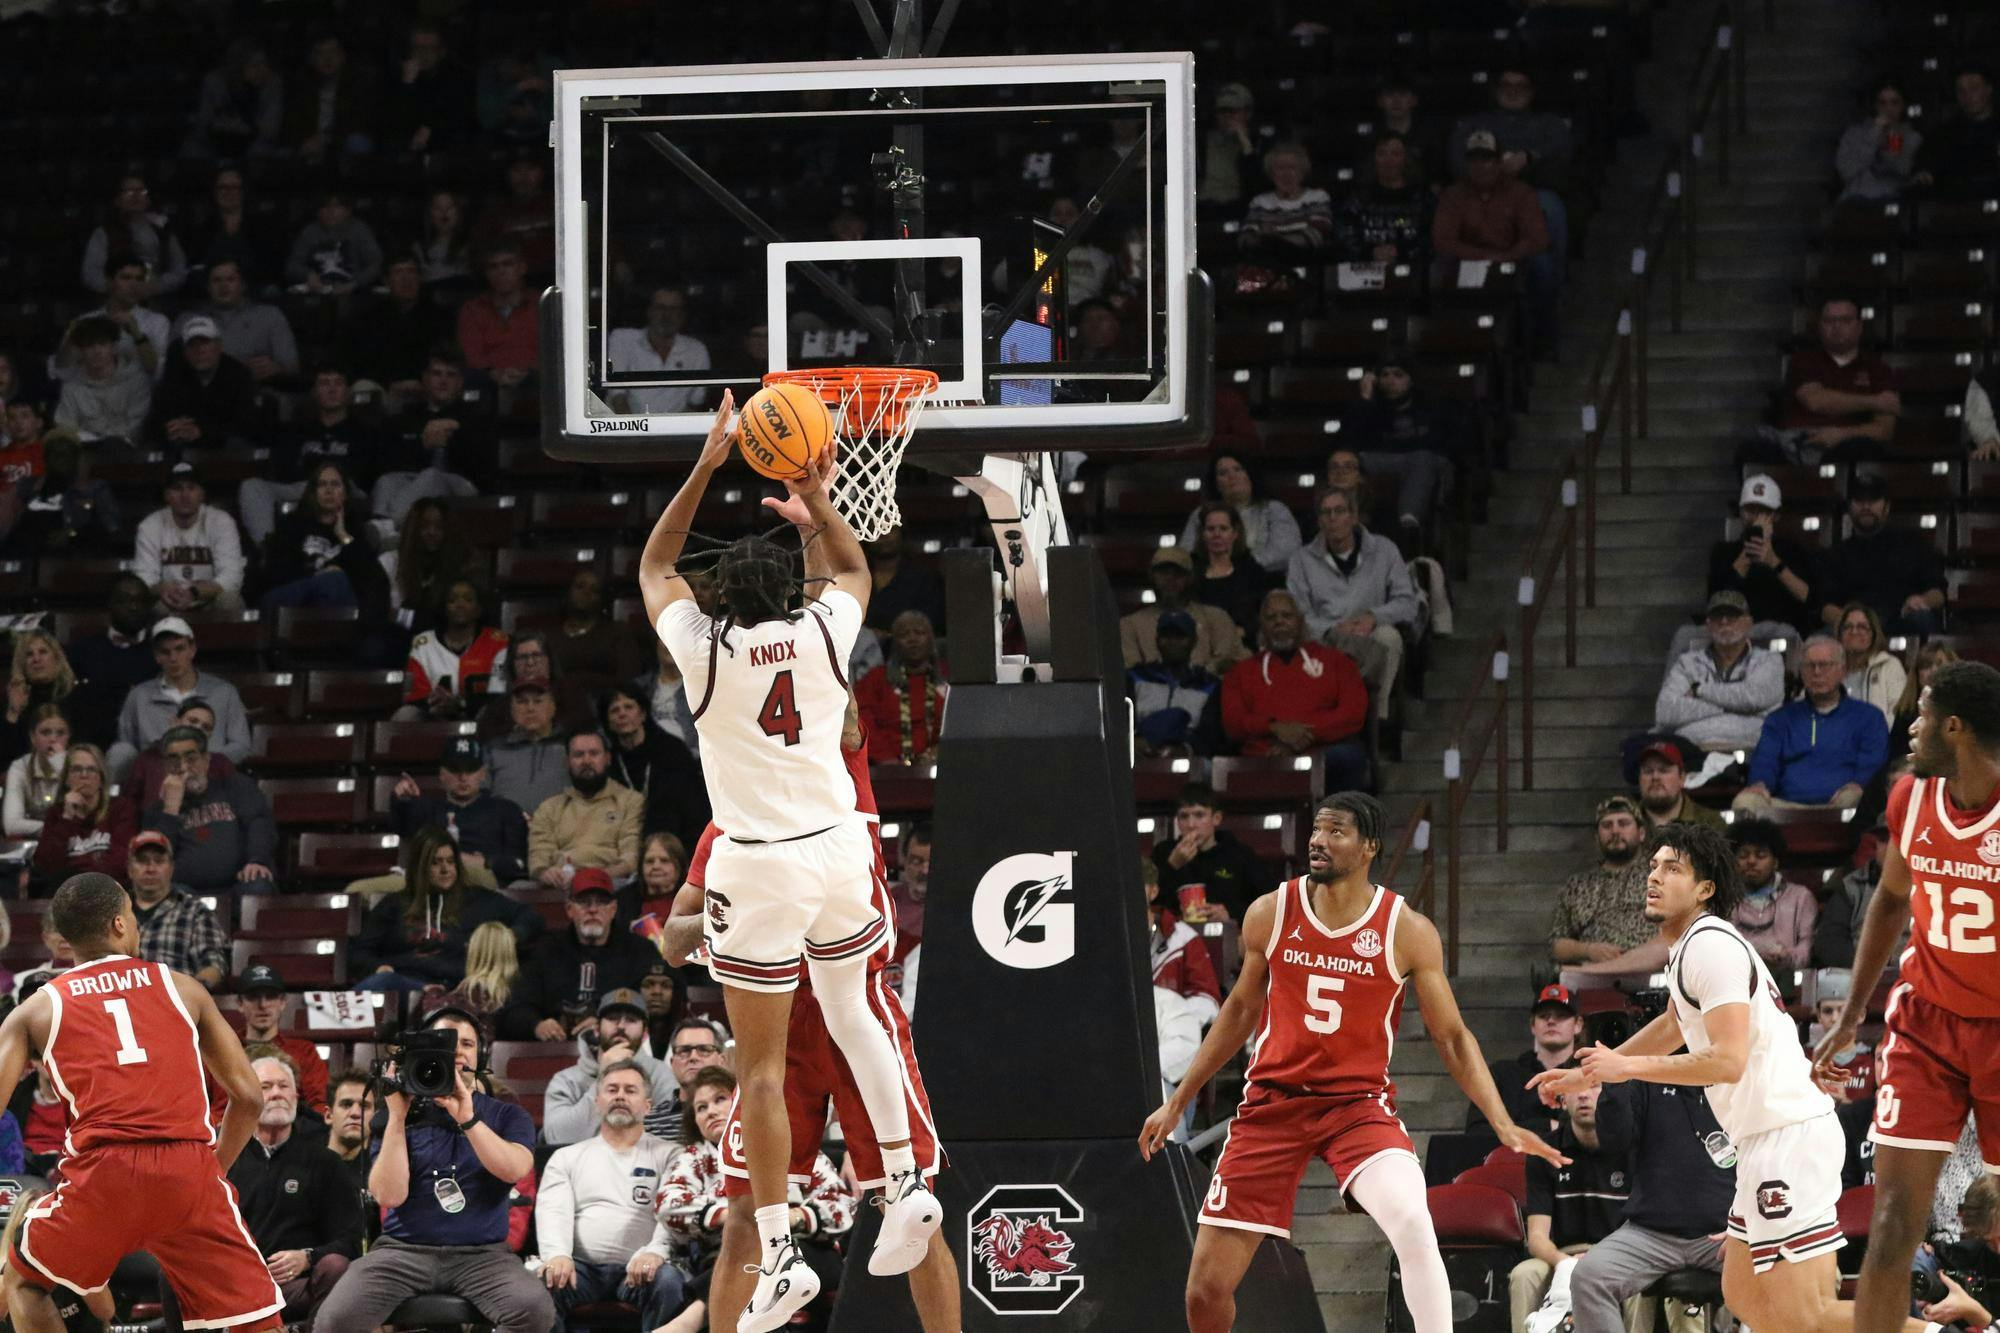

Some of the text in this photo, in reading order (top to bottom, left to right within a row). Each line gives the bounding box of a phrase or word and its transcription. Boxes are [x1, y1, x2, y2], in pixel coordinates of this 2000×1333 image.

[590, 418, 649, 434] SPALDING
[760, 399, 792, 440] NCAA
[749, 639, 797, 667] KNOX
[757, 669, 803, 747] 4
[971, 850, 1076, 970] G
[1922, 880, 1997, 954] 12
[1357, 929, 1379, 951] SEC
[67, 967, 153, 997] BROWN
[1283, 948, 1375, 977] OKLAHOMA
[1304, 973, 1346, 1035] 5
[103, 998, 149, 1066] 1
[1876, 1083, 1902, 1129] OU
[1207, 1173, 1228, 1212] OU
